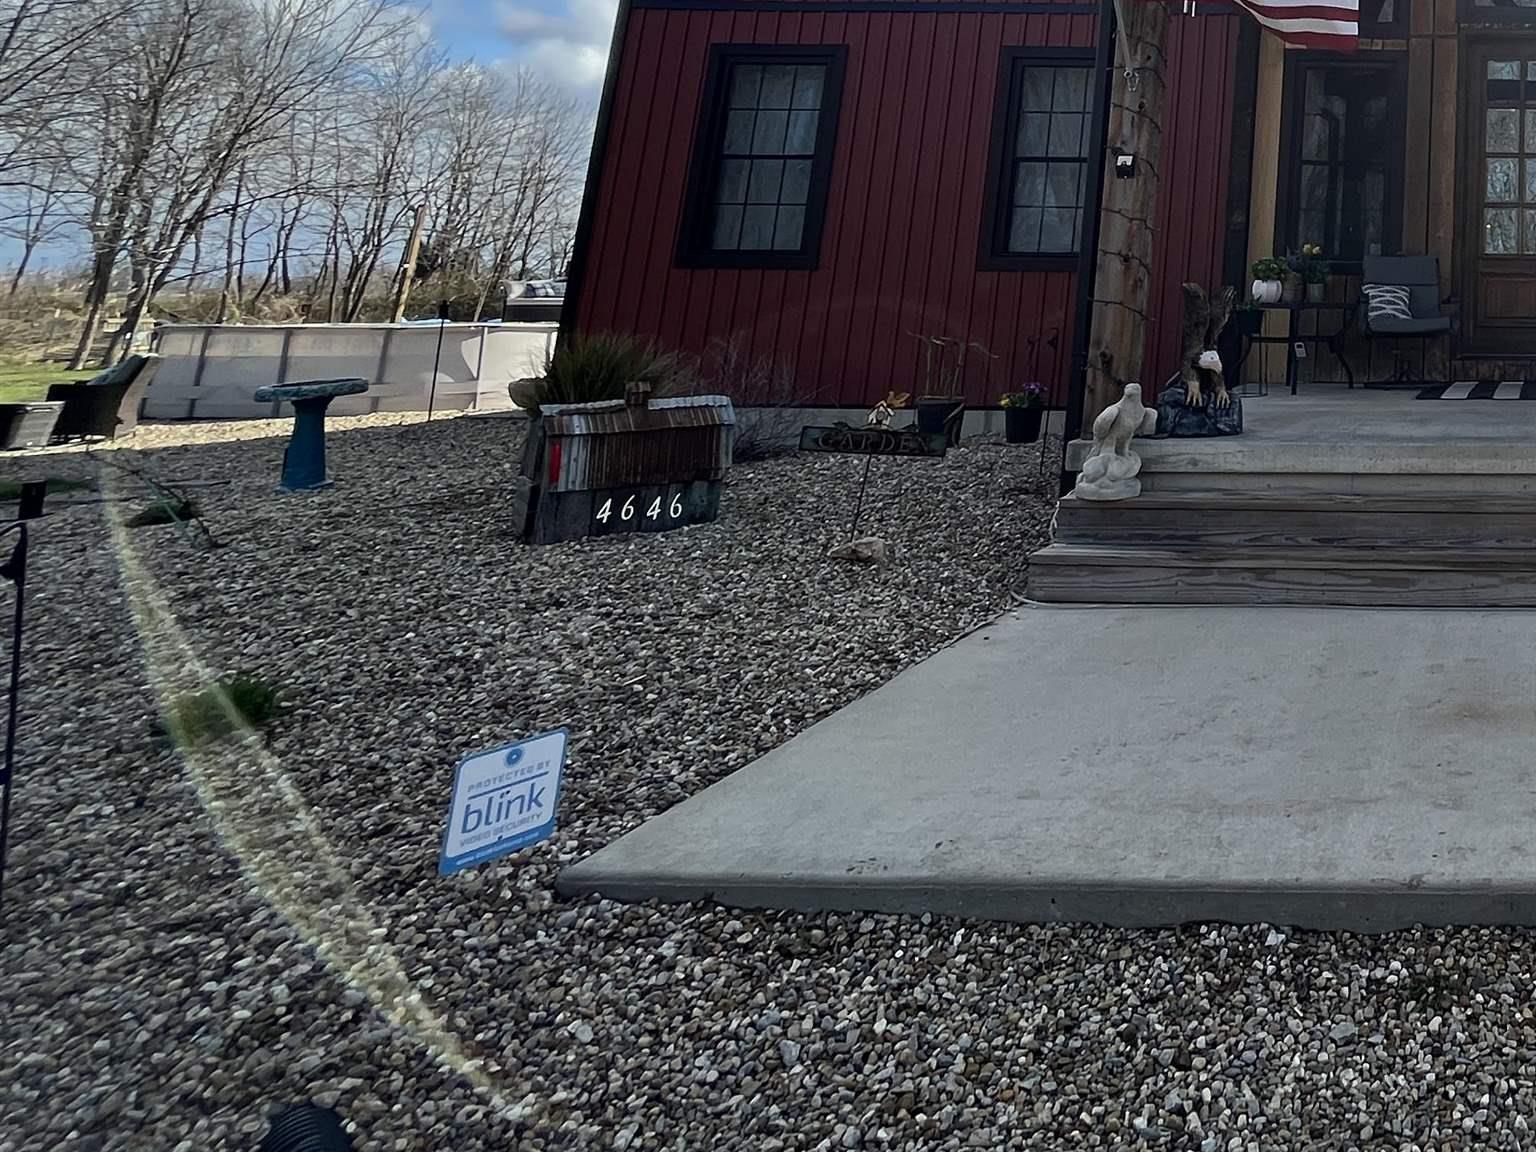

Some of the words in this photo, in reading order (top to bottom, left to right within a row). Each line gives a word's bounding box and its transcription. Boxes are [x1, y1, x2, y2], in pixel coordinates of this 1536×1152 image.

[817, 430, 931, 453] GARDEN
[596, 492, 683, 524] 4646
[467, 765, 534, 792] PROTECTED
[536, 759, 551, 770] BY
[492, 811, 543, 836] SECURITY
